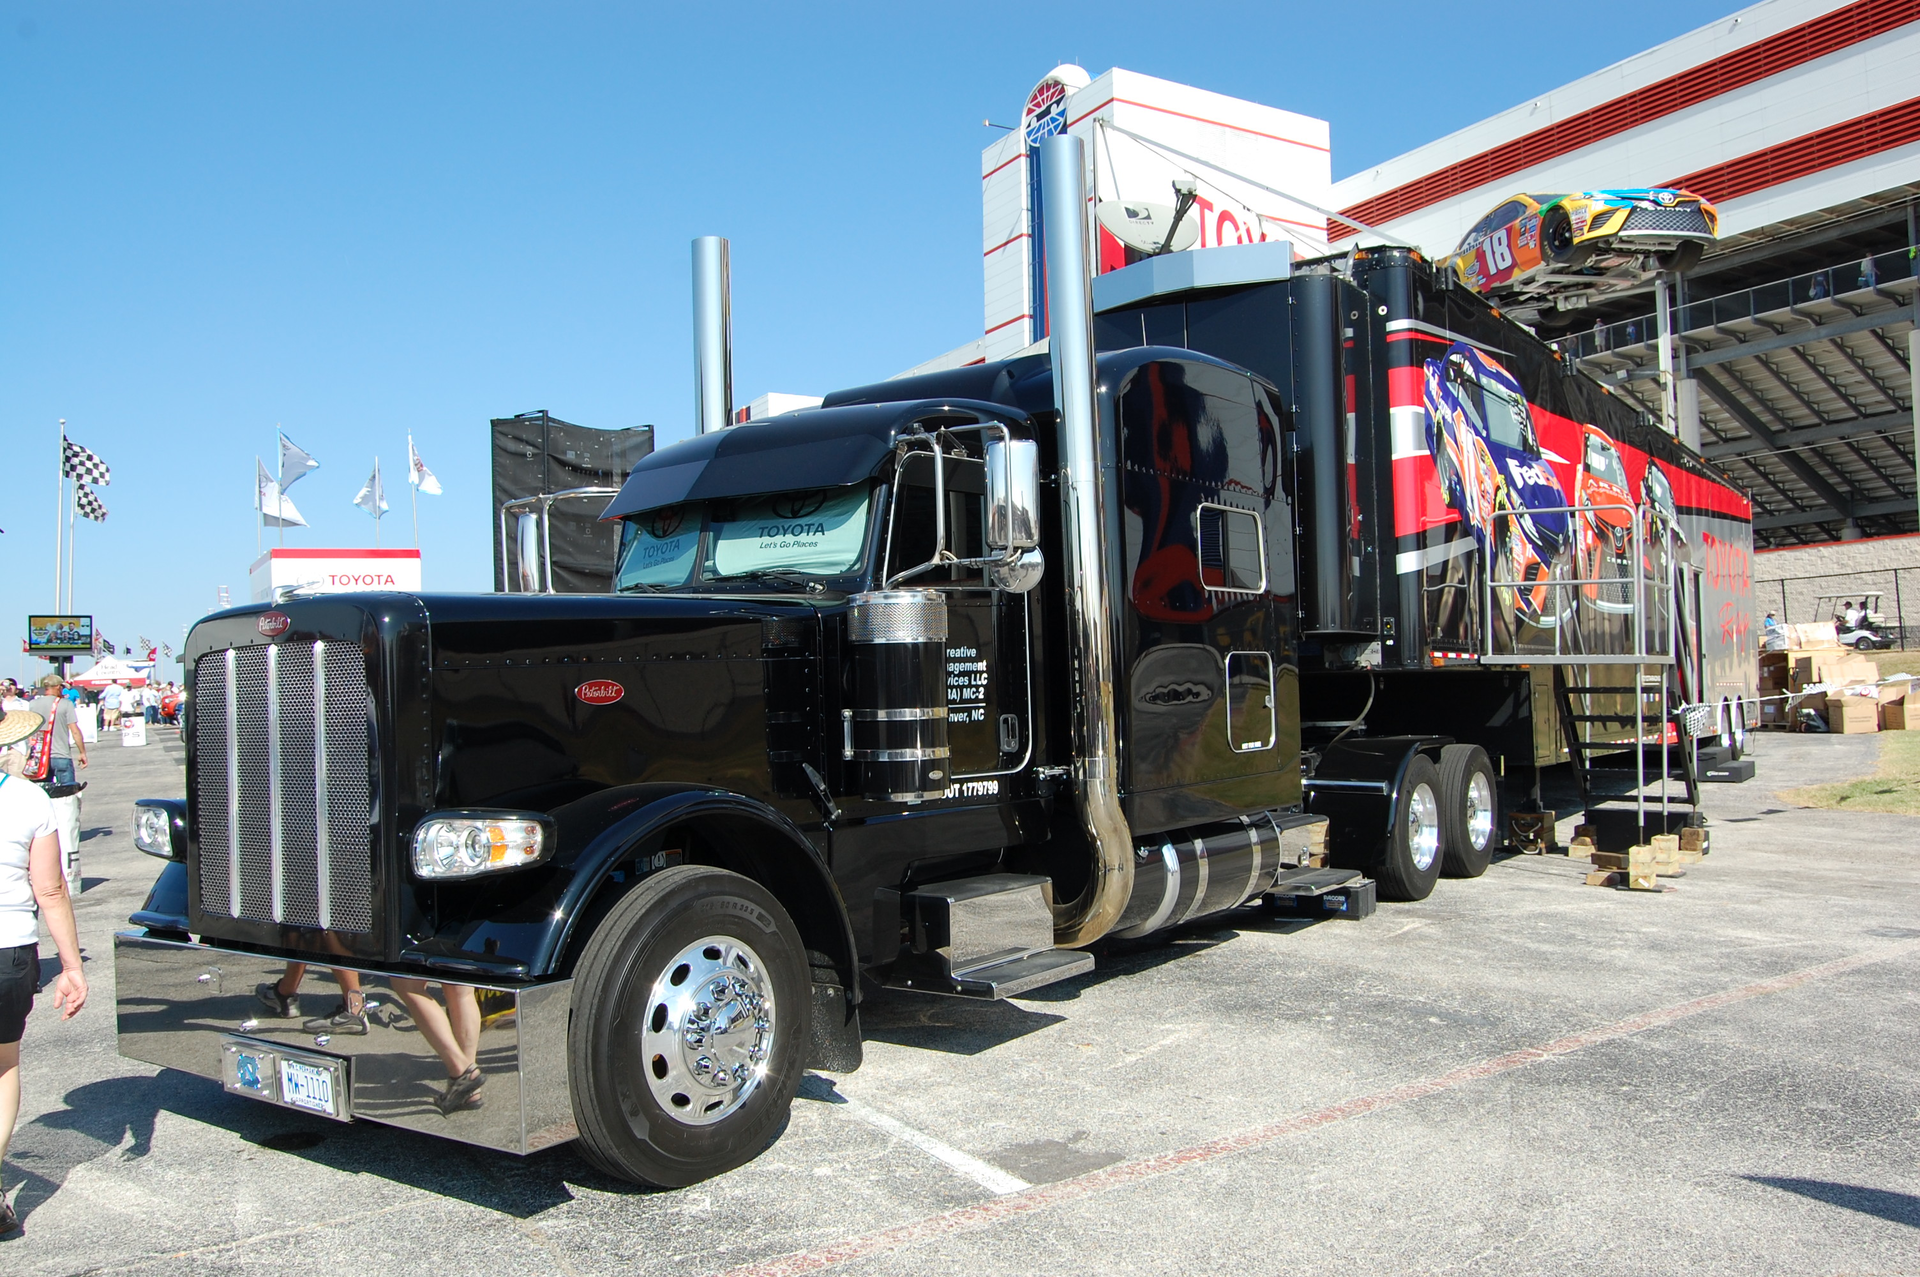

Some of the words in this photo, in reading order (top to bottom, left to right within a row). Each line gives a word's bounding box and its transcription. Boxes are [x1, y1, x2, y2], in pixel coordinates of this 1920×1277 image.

[1482, 228, 1513, 276] 18
[757, 522, 826, 539] TOYOTA
[642, 538, 681, 560] TOYOTA
[759, 541, 778, 549] Let's
[779, 540, 791, 549] Go
[791, 540, 819, 549] Places
[1702, 531, 1752, 599] TOYOTA
[328, 574, 396, 586] TOYOTA
[946, 646, 977, 658] reative
[946, 659, 988, 675] agement
[970, 672, 988, 686] LLC
[582, 684, 620, 699] Peterbilt
[962, 686, 985, 700] MC-2
[948, 710, 969, 724] nver,
[971, 708, 985, 721] NC
[962, 780, 999, 797] 1779799
